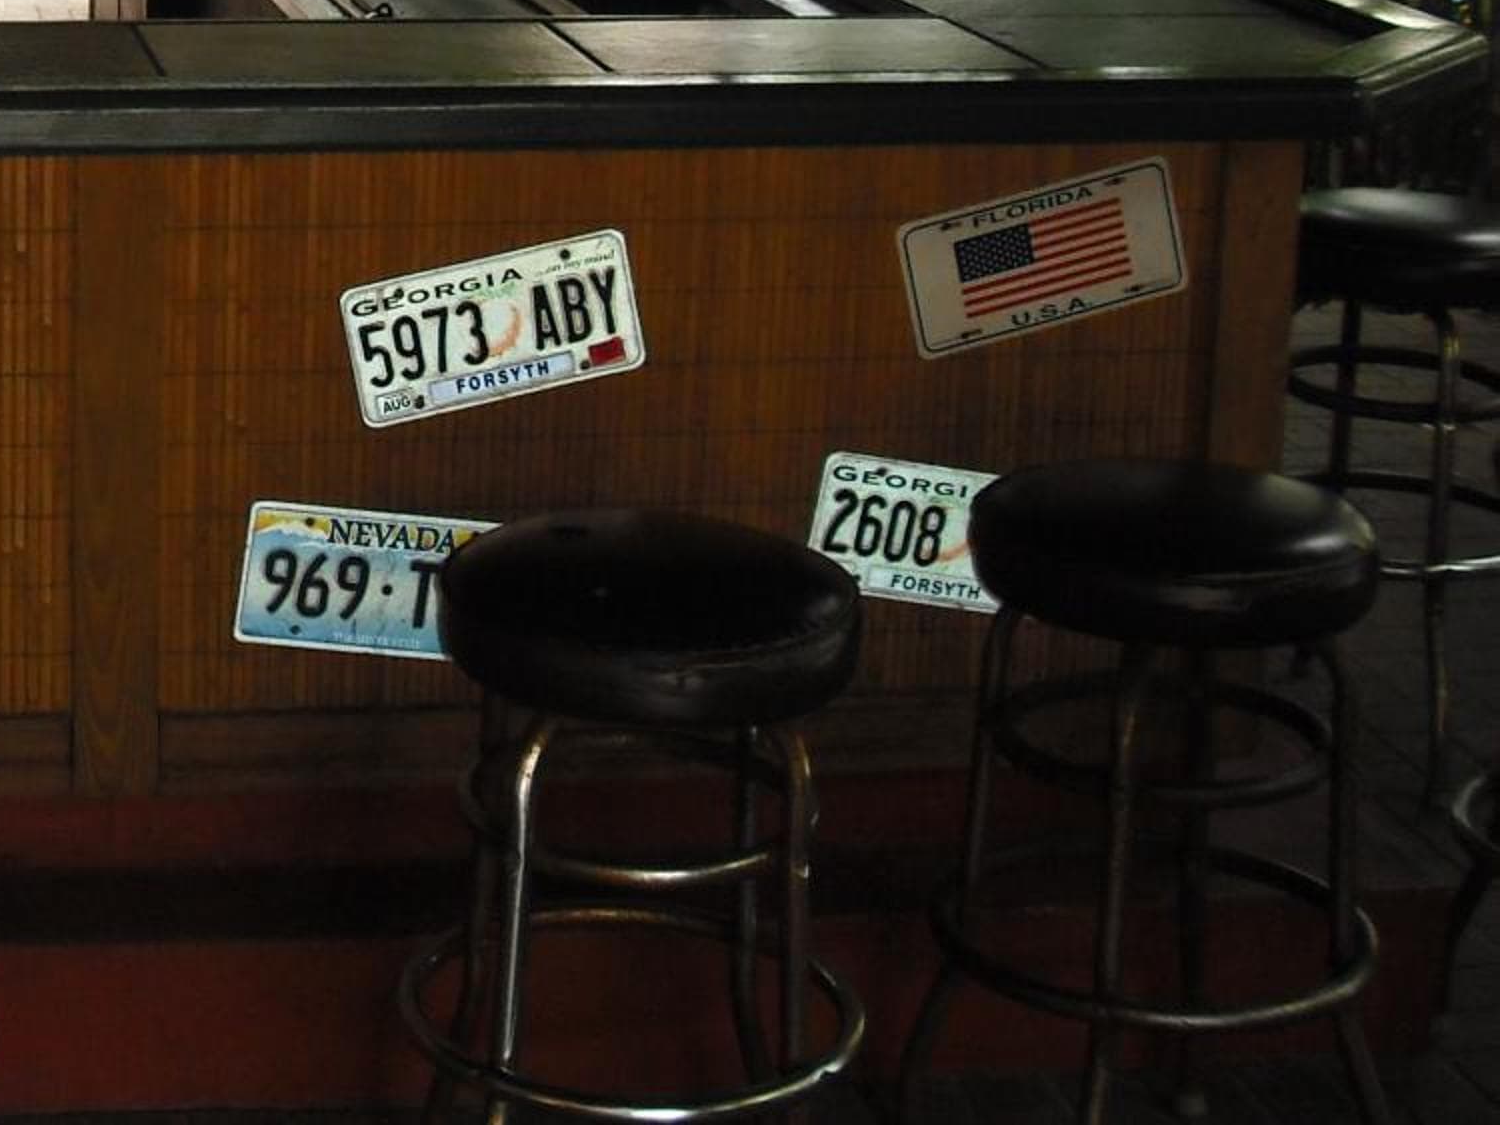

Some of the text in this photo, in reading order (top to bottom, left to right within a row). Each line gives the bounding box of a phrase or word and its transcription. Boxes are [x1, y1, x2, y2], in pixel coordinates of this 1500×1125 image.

[972, 186, 1094, 227] FLORIDA
[351, 267, 523, 317] GEORGIA
[357, 268, 617, 388] 5973 ABY
[455, 361, 551, 394] FORSYTH
[382, 395, 412, 415] AUG
[833, 465, 968, 498] GEORGI
[327, 519, 458, 553] NEVADA
[823, 488, 947, 567] 2608
[890, 574, 981, 600] FORSYTH
